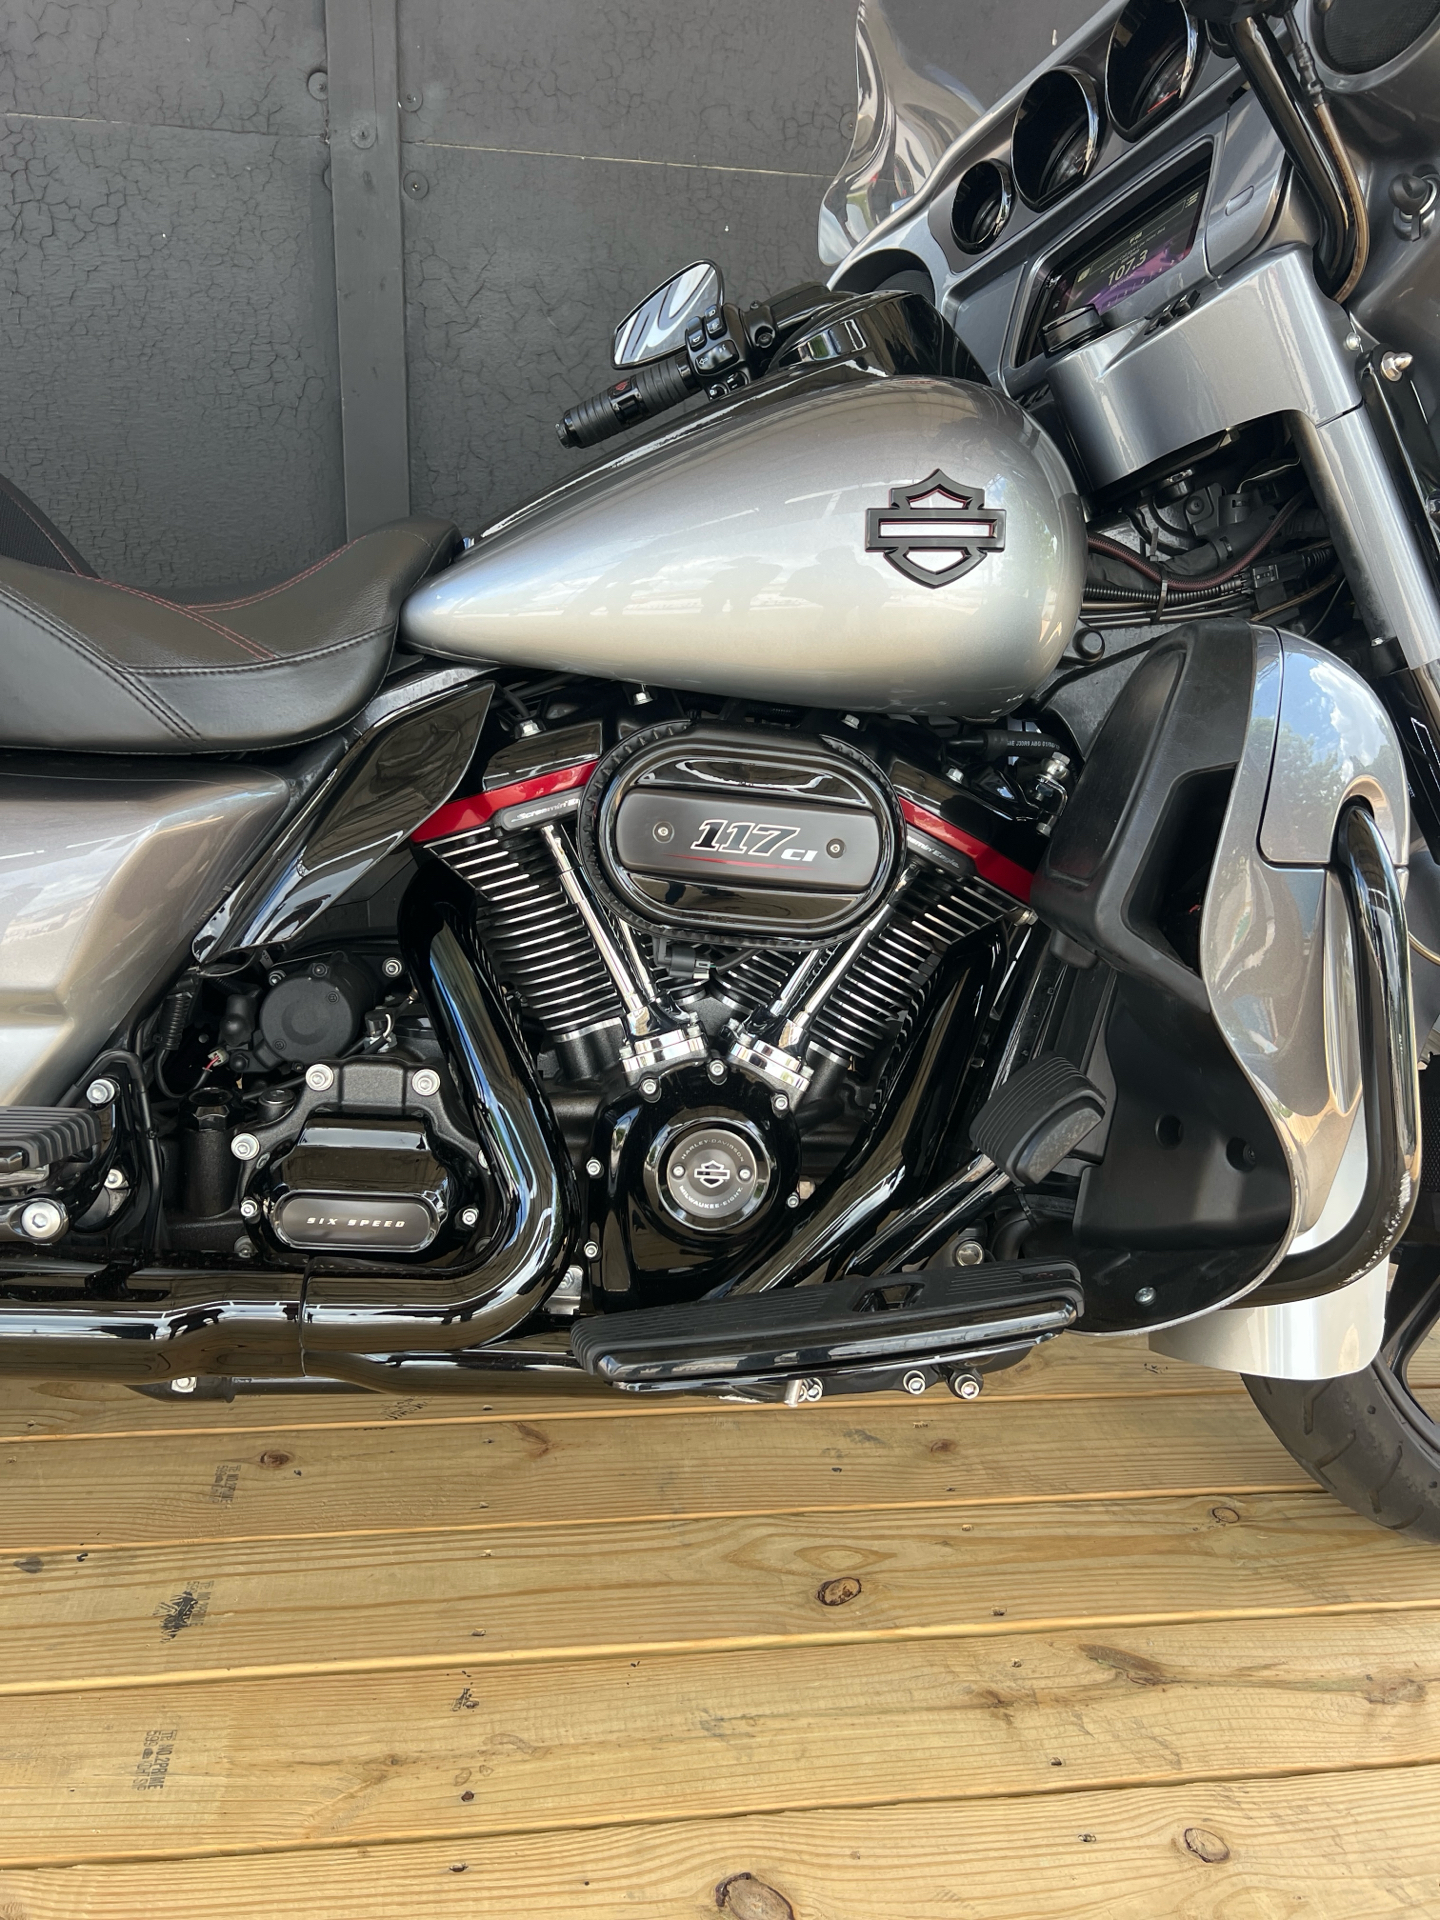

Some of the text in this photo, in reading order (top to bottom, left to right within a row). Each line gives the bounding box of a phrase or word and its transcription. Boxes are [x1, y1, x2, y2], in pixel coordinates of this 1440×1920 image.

[1107, 249, 1149, 286] 107.3
[690, 819, 818, 862] 117 CI
[306, 1217, 406, 1228] SIX SPEED
